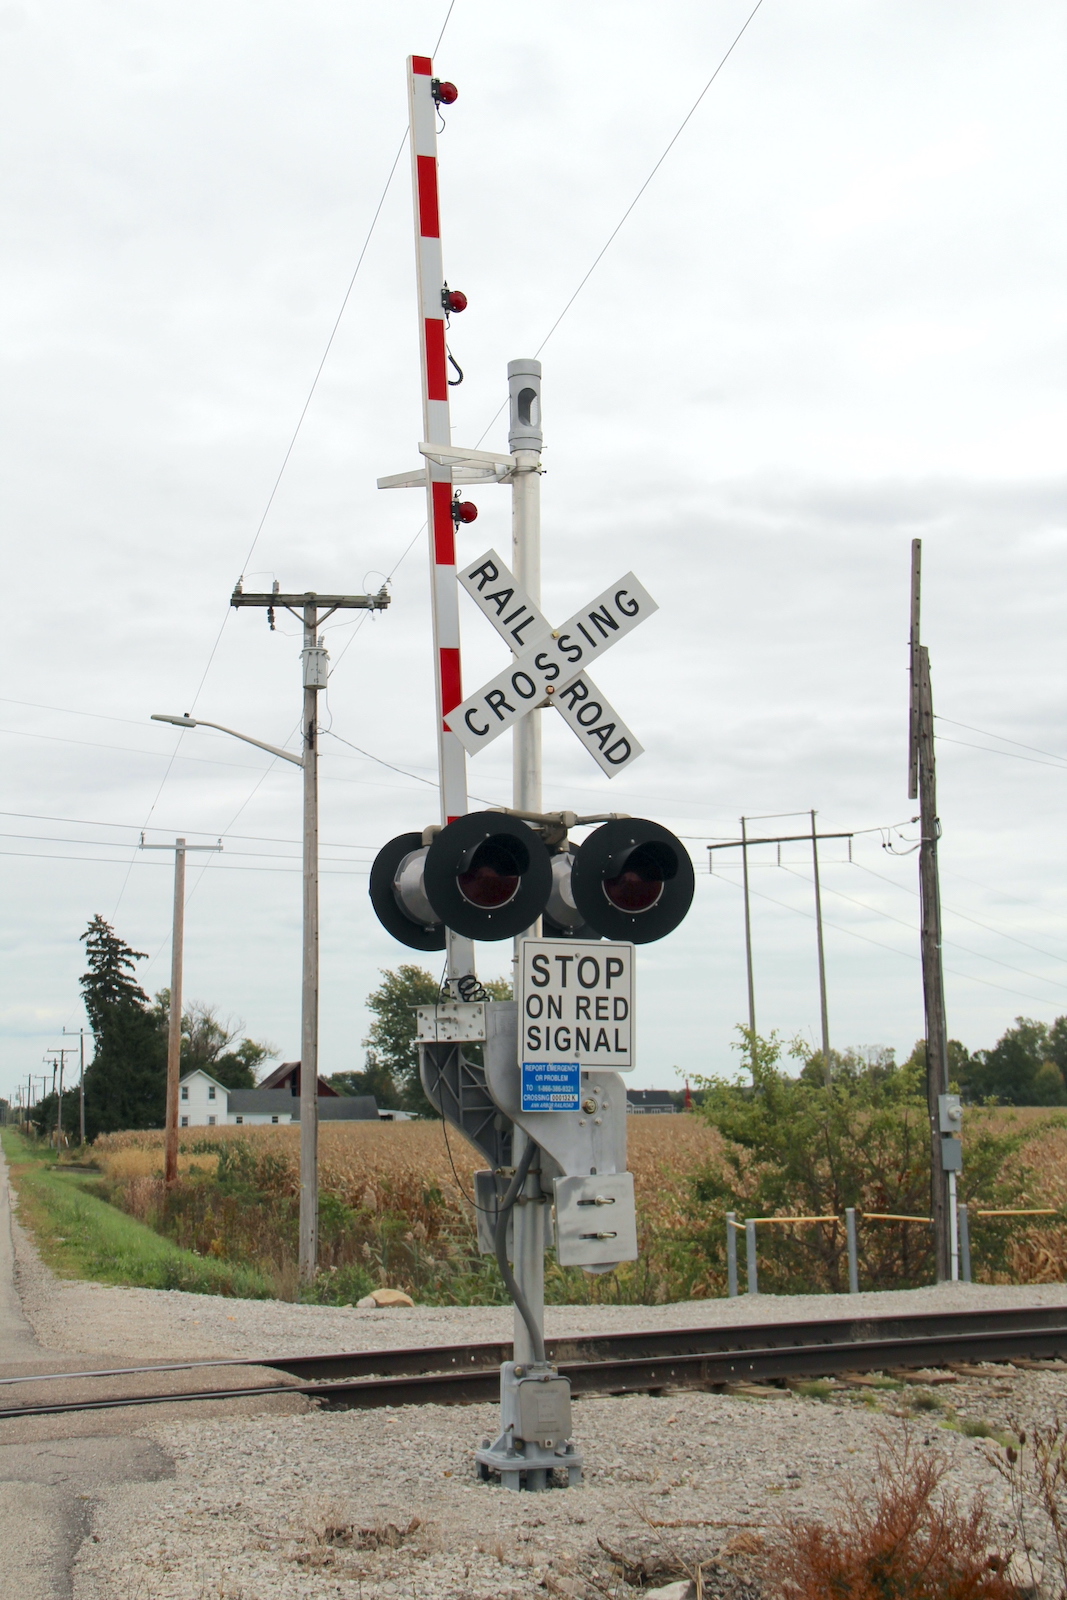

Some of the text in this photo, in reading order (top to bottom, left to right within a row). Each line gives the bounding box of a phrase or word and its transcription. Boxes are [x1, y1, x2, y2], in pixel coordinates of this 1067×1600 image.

[469, 560, 534, 646] RAIL
[465, 590, 639, 735] CROSSING
[559, 679, 631, 764] ROAD
[531, 954, 624, 989] STOP
[526, 994, 628, 1020] ON RED
[527, 1026, 627, 1052] SIGNAL
